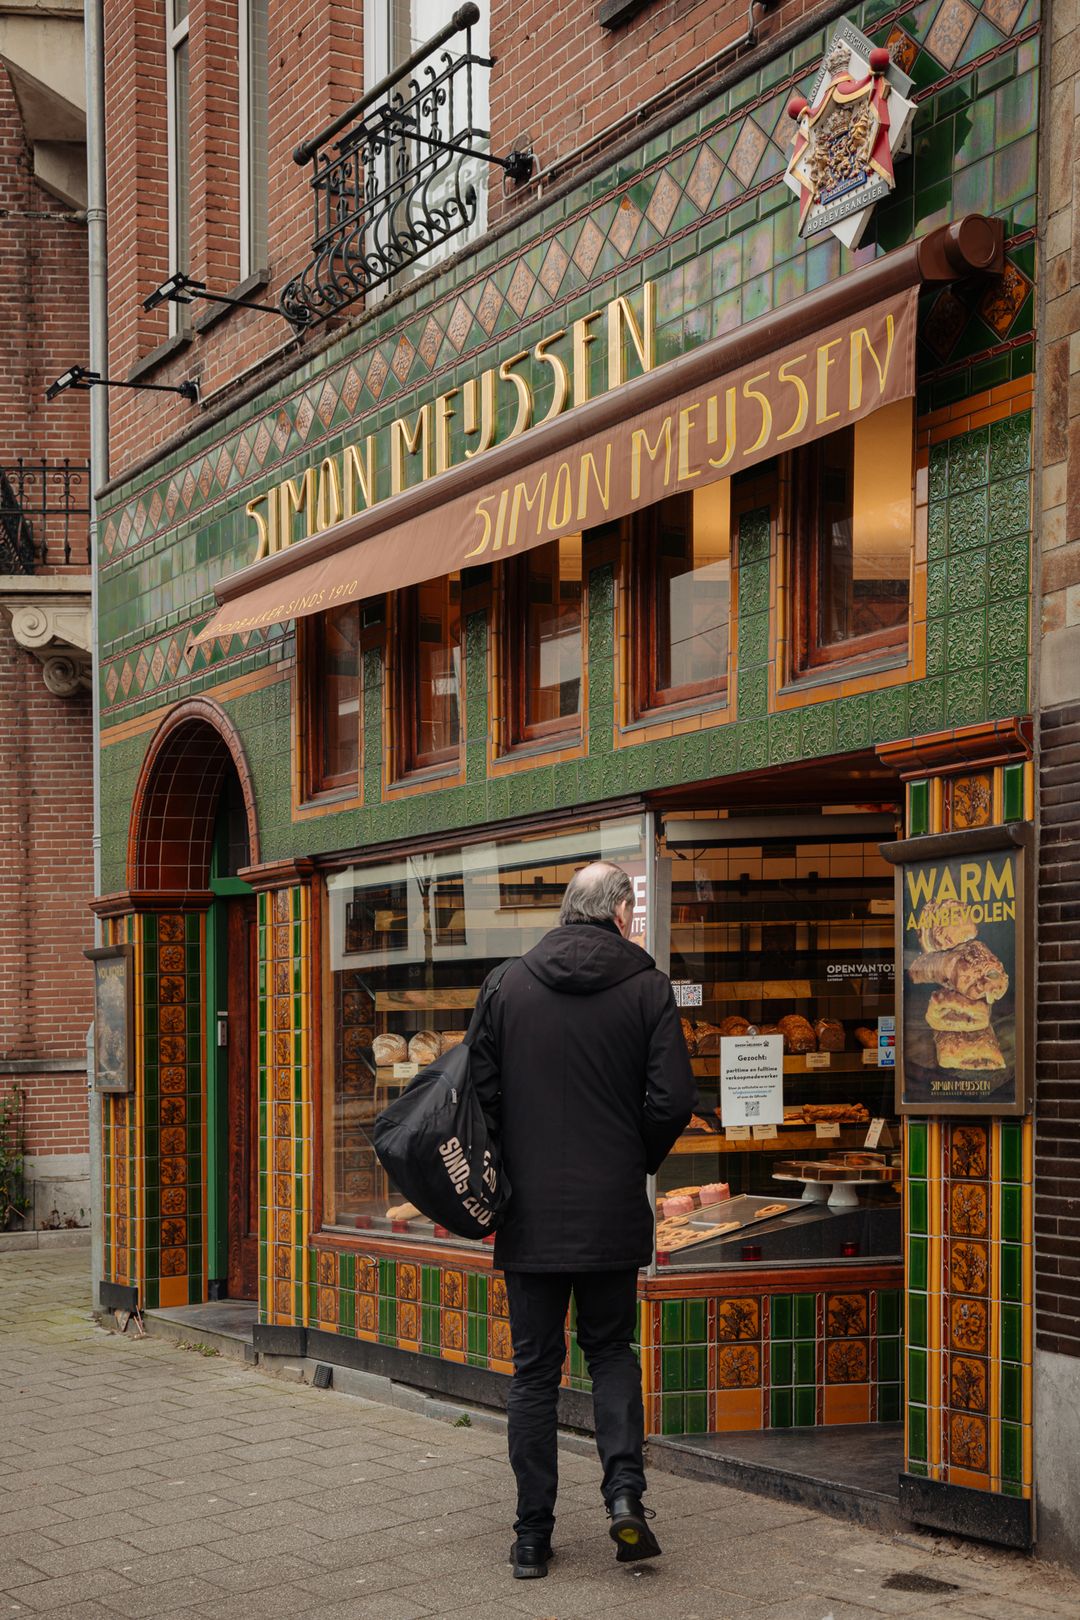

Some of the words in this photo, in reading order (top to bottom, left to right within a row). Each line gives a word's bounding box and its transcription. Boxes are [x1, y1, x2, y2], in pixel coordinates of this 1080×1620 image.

[807, 186, 883, 232] HOFLEVERANCIER
[246, 435, 376, 565] SIMON
[464, 443, 612, 559] SIMON
[286, 589, 325, 615] SINDS
[328, 580, 358, 600] 1910
[906, 857, 1015, 910] WARM
[906, 901, 1016, 931] AANBEVOLEN
[827, 964, 855, 974] OPEN
[856, 963, 876, 973] VAN
[725, 1073, 778, 1081] verkoopmedewerker
[737, 1054, 767, 1062] Gezocht:
[439, 1136, 471, 1195] SINDS
